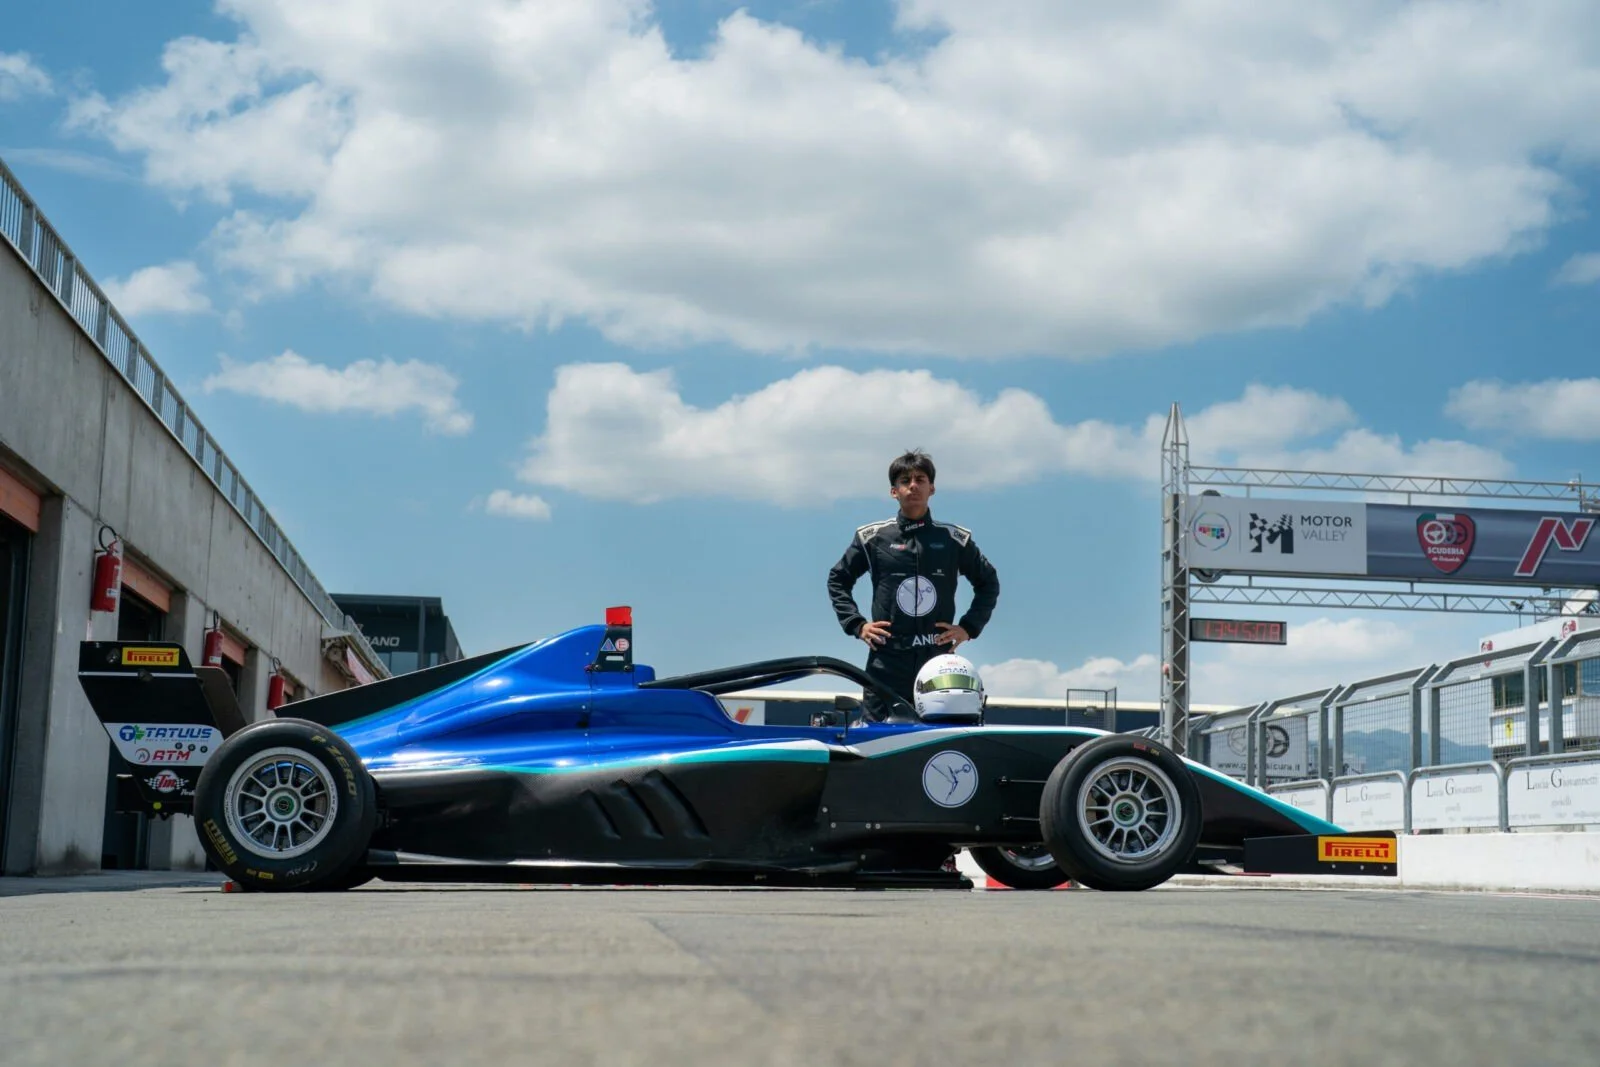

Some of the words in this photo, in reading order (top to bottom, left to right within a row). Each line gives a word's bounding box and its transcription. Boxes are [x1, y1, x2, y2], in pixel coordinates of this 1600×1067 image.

[1301, 515, 1352, 528] MOTOR
[1301, 530, 1347, 542] VALLEY
[1427, 546, 1465, 556] SCUDERIA
[127, 650, 174, 663] PIRELLI
[145, 727, 213, 739] TATUUS
[152, 750, 191, 761] ATM
[325, 745, 358, 796] ZERO
[1526, 771, 1549, 790] Lucia
[1324, 841, 1389, 858] PIRELLI
